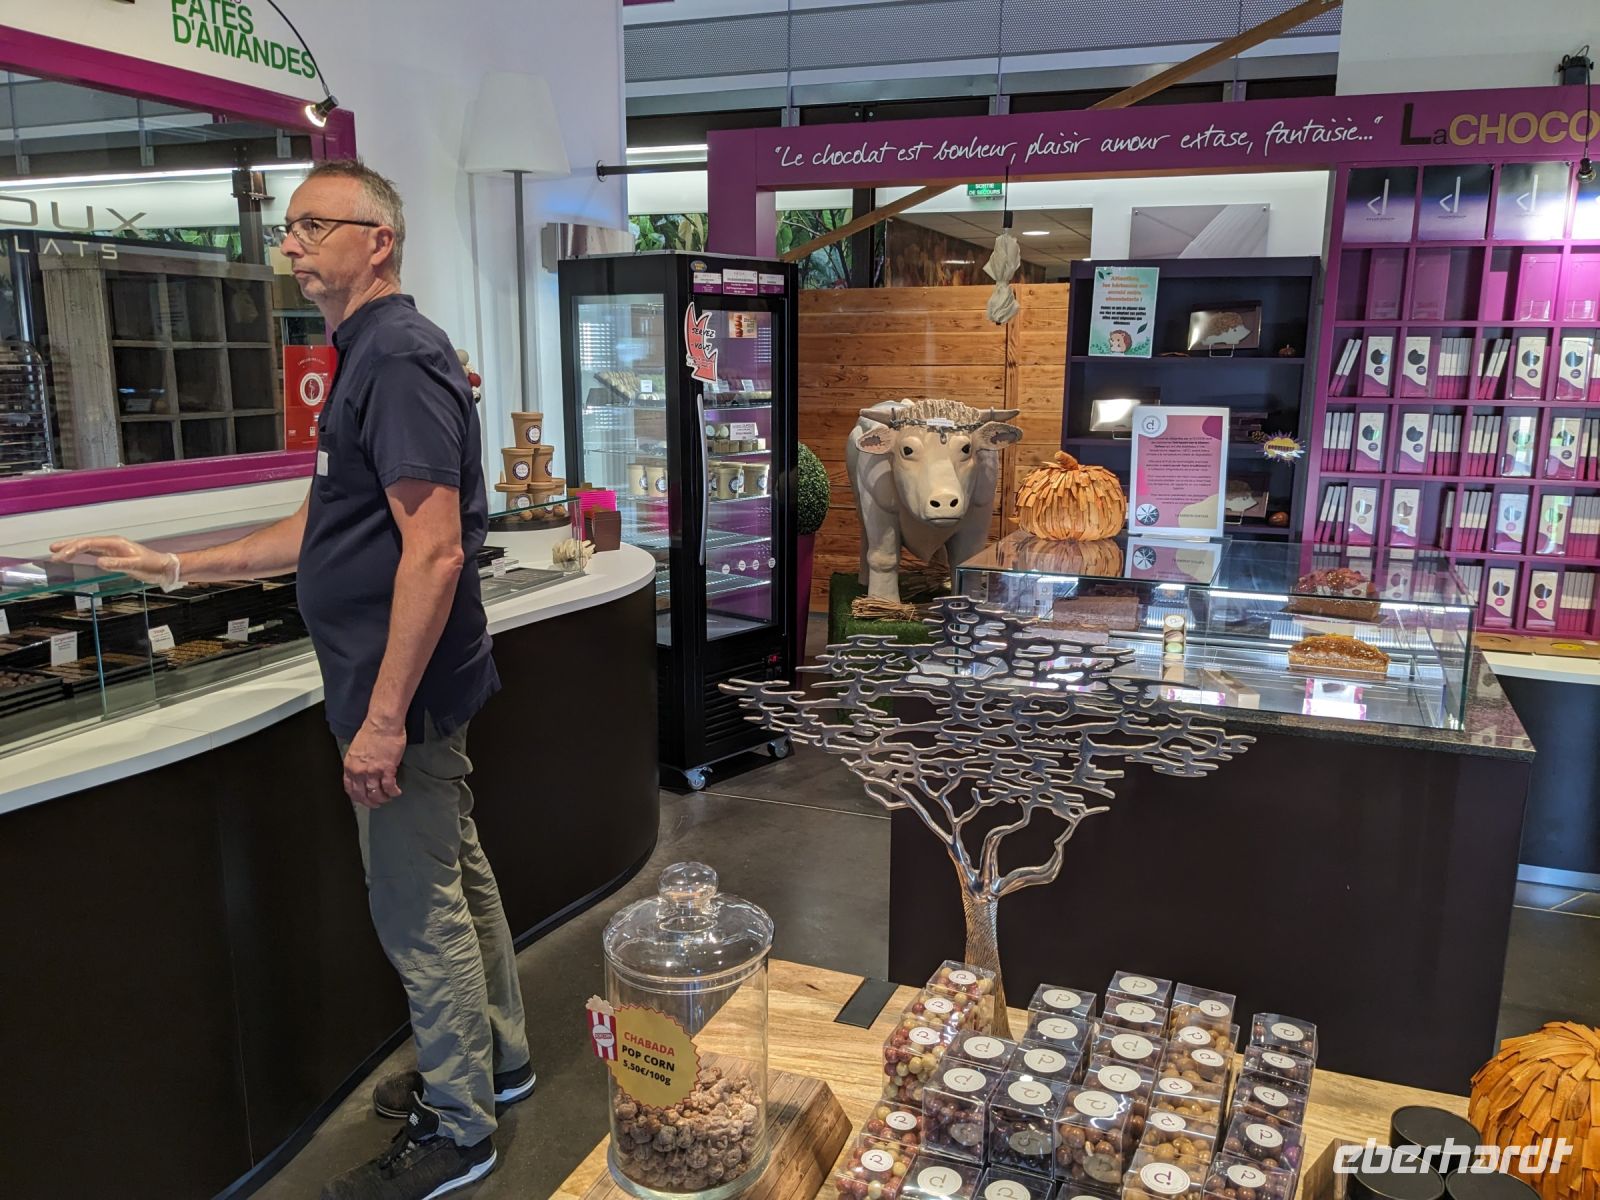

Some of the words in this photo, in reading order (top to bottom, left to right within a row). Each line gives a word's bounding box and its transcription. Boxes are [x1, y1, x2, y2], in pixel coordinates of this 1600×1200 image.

[172, 13, 316, 79] D'AMANDES
[811, 142, 897, 166] chocolat
[896, 143, 932, 161] est
[932, 136, 1019, 165] bonheur,
[1024, 131, 1091, 164] plaisir
[1100, 134, 1171, 153] amour
[1180, 123, 1254, 155] extase,
[692, 327, 715, 338] SERVEZ
[623, 1031, 675, 1057] CHABADA
[621, 1045, 642, 1060] POP
[643, 1053, 676, 1073] CORN
